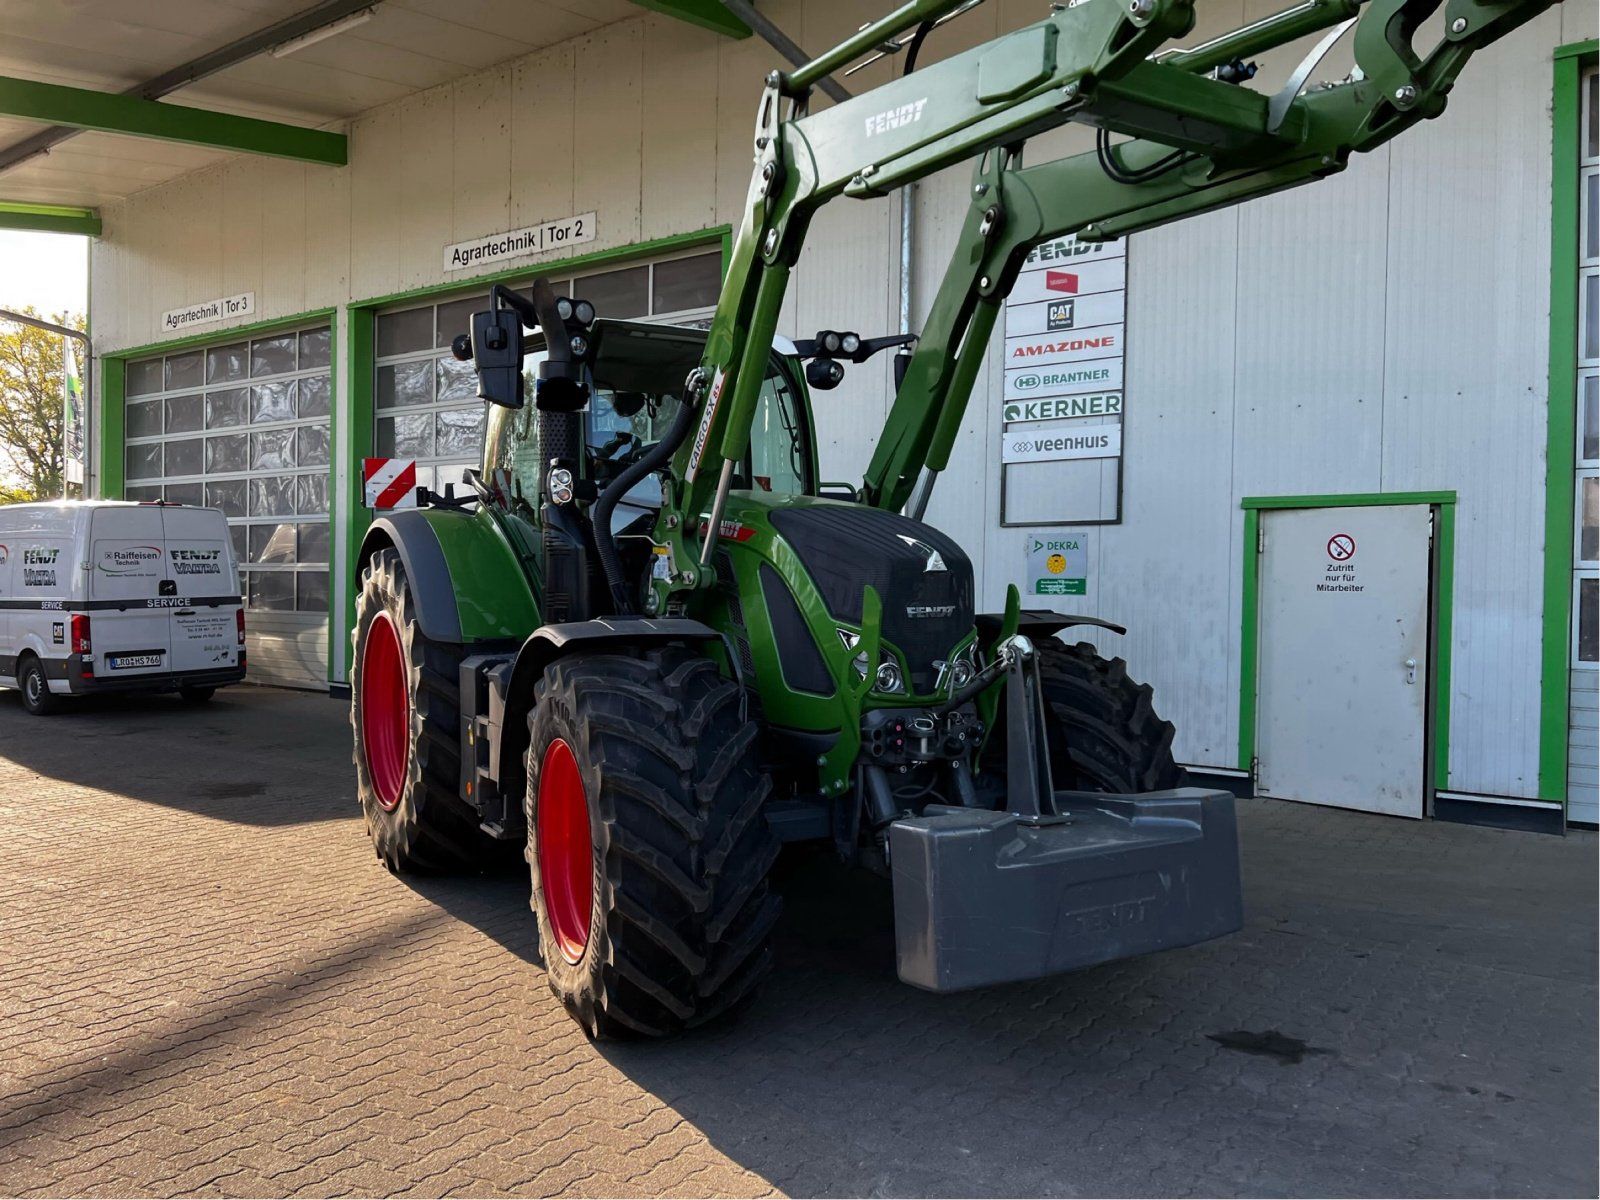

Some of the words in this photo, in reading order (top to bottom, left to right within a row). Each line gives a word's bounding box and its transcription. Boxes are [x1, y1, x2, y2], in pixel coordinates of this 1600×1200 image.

[865, 97, 928, 137] FENDT
[452, 232, 535, 266] Agrartechnik
[548, 226, 571, 242] Tor
[575, 220, 583, 237] 2
[166, 304, 219, 328] Agrartechnik
[226, 300, 240, 313] Tor
[242, 297, 247, 309] 3
[1050, 304, 1072, 320] CAT
[1013, 336, 1115, 358] AMAZONE
[1043, 369, 1110, 385] BRANTNER
[1025, 395, 1120, 420] KERNER
[690, 420, 708, 470] CARGO
[1047, 541, 1079, 551] DEKRA
[24, 549, 60, 564] FENDT
[114, 551, 158, 560] Raiffeisen
[170, 550, 221, 560] FENDT
[1327, 564, 1354, 572] Zutritt
[1342, 574, 1355, 582] für
[1316, 584, 1364, 592] Mitarbeiter
[41, 601, 63, 610] SERVICE
[147, 598, 191, 608] SERVICE
[906, 605, 956, 618] FENDT
[115, 657, 130, 667] LRO
[145, 655, 160, 664] 766
